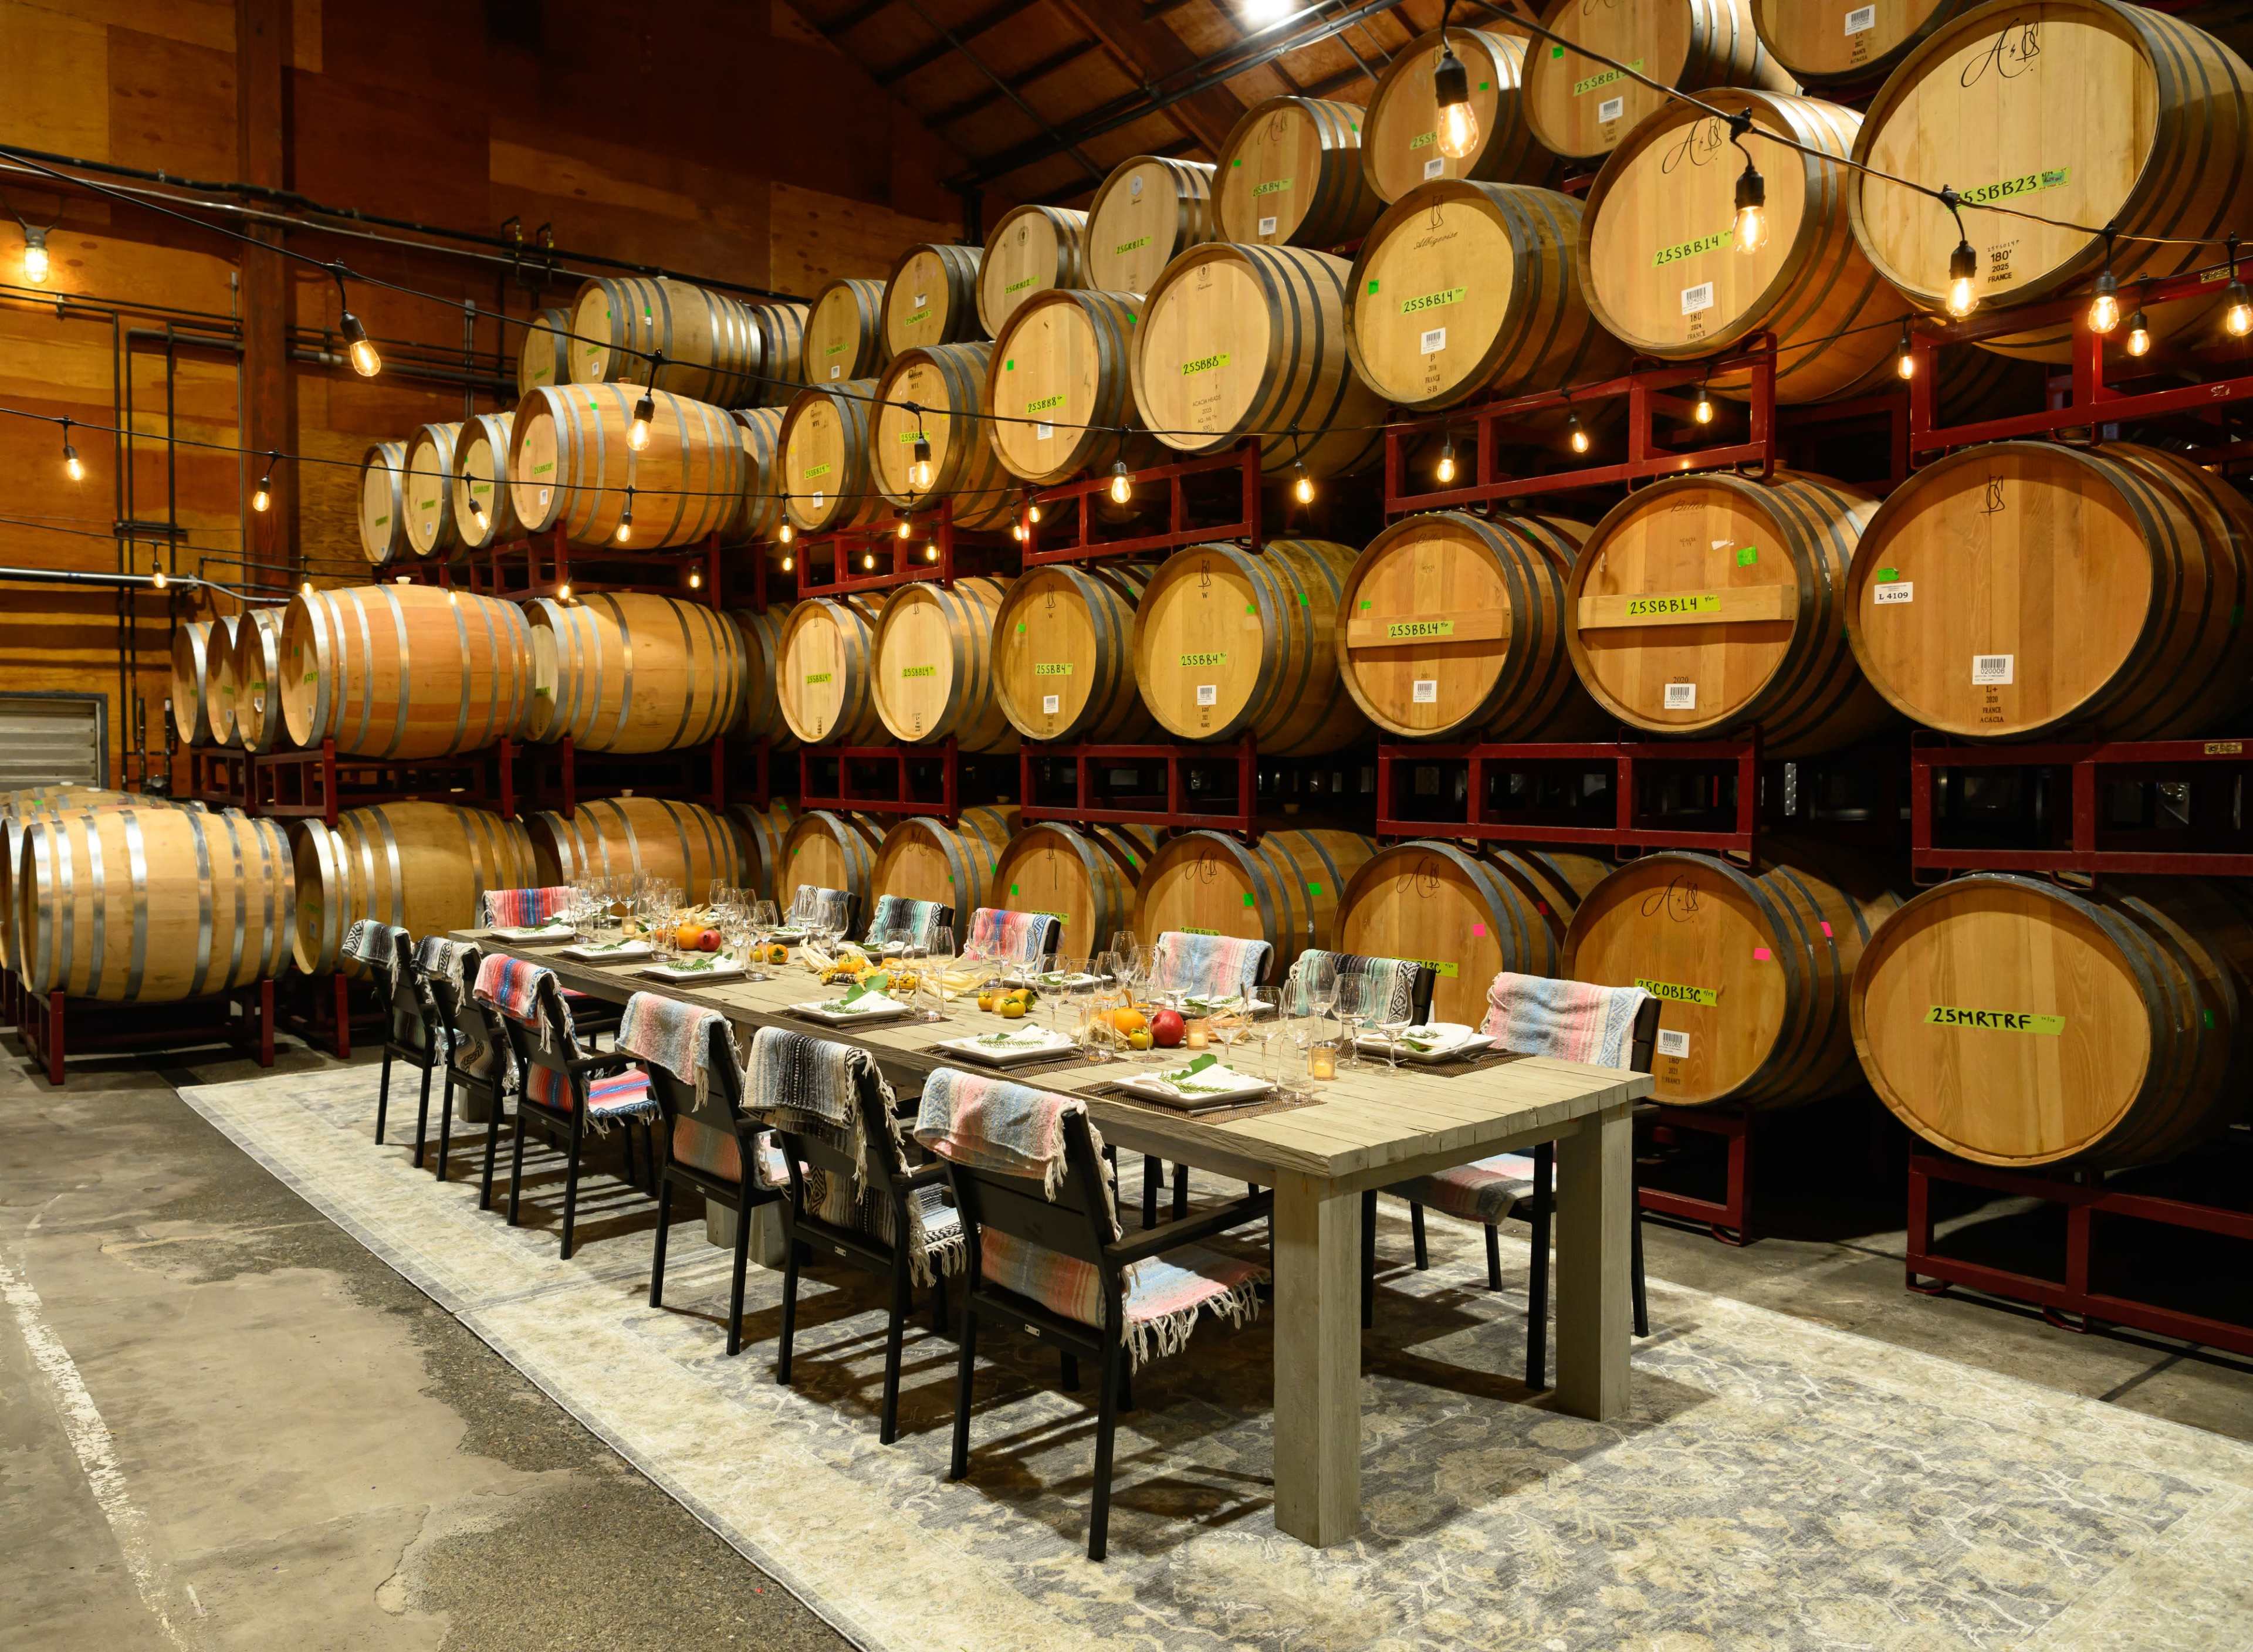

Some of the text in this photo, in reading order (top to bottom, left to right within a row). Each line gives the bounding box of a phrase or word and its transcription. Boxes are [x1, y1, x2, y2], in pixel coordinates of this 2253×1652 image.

[1657, 234, 1720, 266] 25SBB14
[1992, 262, 2010, 273] 2025
[1988, 272, 2012, 283] FRANCE
[1403, 290, 1453, 313] 25SBB14
[1687, 330, 1706, 340] FRANCE
[1183, 356, 1219, 375] 25SBB8
[1425, 374, 1441, 383] FRANCE
[1028, 396, 1057, 414] 25SBB8
[1630, 597, 1698, 615] 25SBB14
[1391, 622, 1439, 637] 25SBB14
[1181, 654, 1219, 666] 25SBB4
[1037, 664, 1066, 674] 25SBB4
[1673, 676, 1689, 684] 2020
[1985, 695, 1998, 704] 2020
[1933, 1007, 2032, 1030] 25MRTRF
